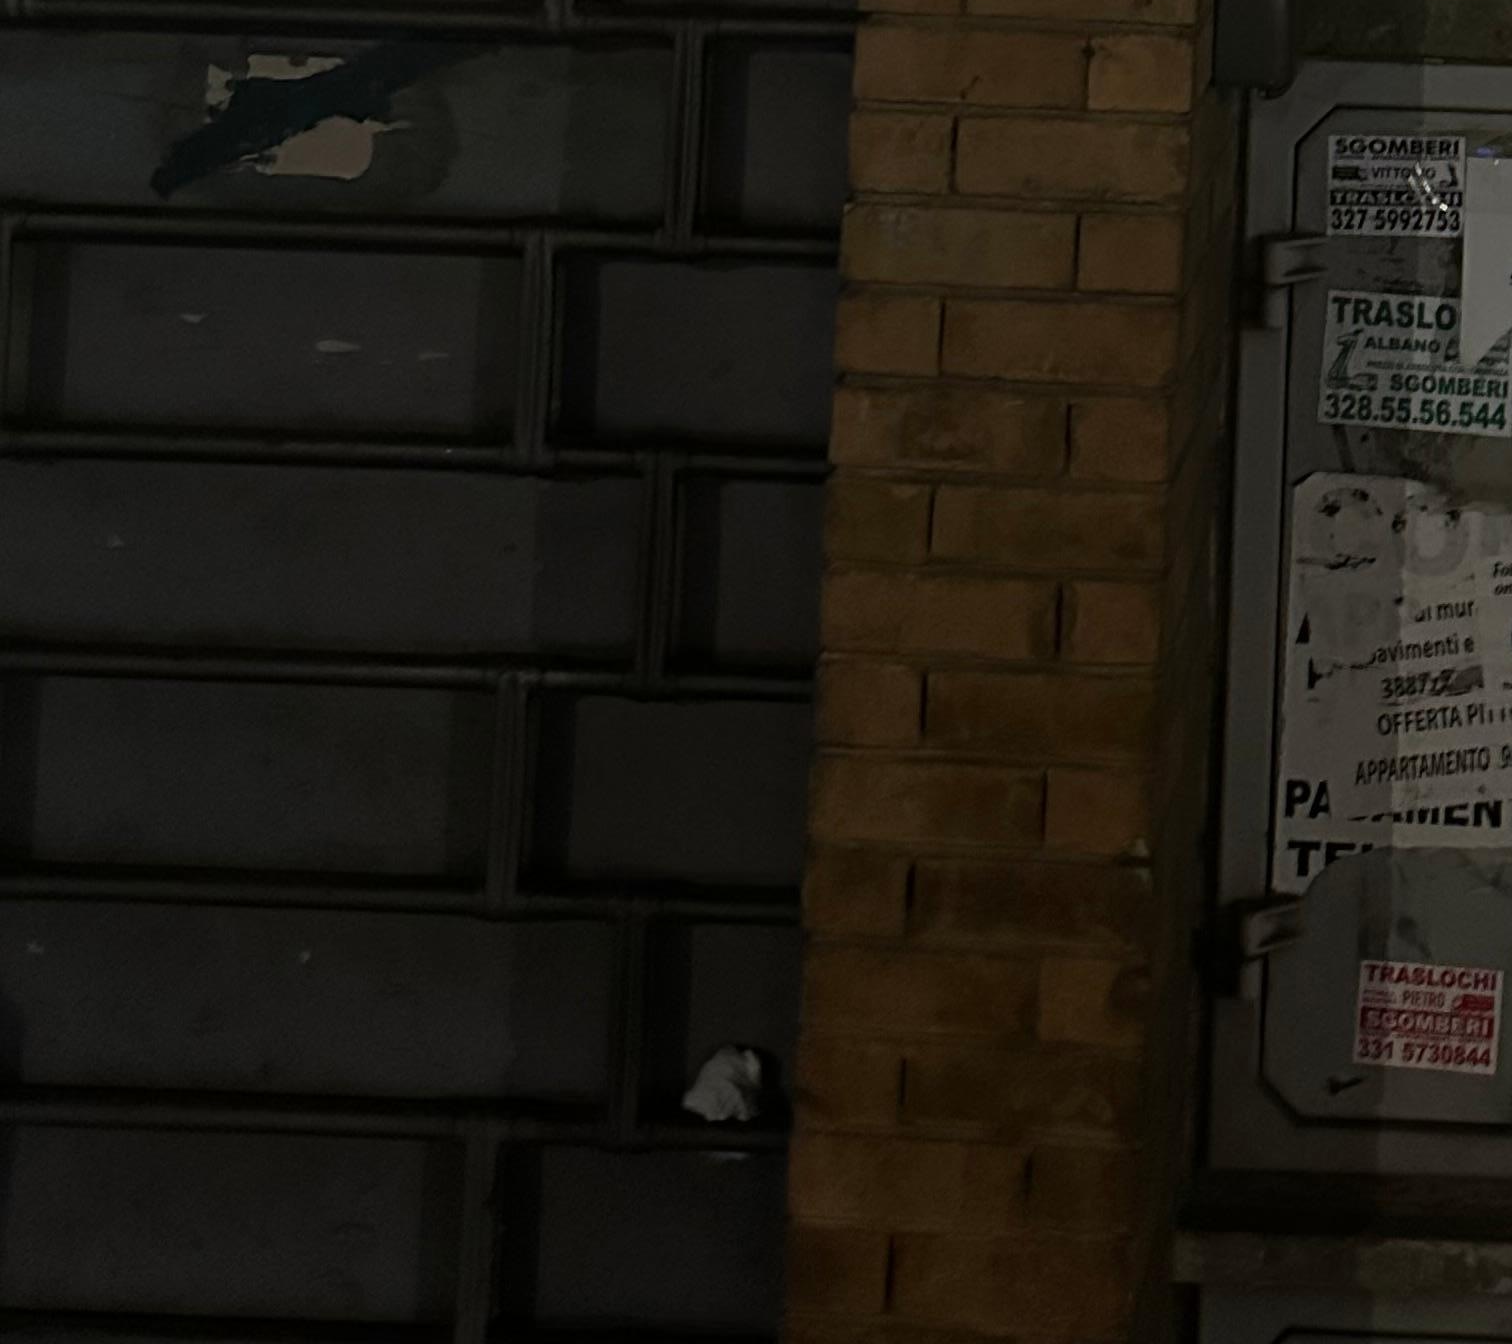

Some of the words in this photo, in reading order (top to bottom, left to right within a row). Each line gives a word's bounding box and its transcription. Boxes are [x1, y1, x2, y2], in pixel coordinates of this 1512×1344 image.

[1336, 138, 1459, 156] SGOMBERI
[1332, 209, 1367, 230] 327
[1374, 210, 1459, 231] 5992753
[1365, 337, 1440, 353] ALBANO
[1391, 374, 1507, 398] SGOMBERI
[1325, 393, 1506, 430] 328.55.56.544
[1495, 584, 1512, 595] on
[1377, 705, 1462, 736] OFFERTA
[1355, 746, 1490, 786] APPARTAMENTO
[1364, 964, 1497, 991] TRASLOCHI
[1402, 990, 1446, 1009] PIETRO
[1369, 1010, 1490, 1036] SGOMBERI
[1402, 1042, 1490, 1066] 5730844
